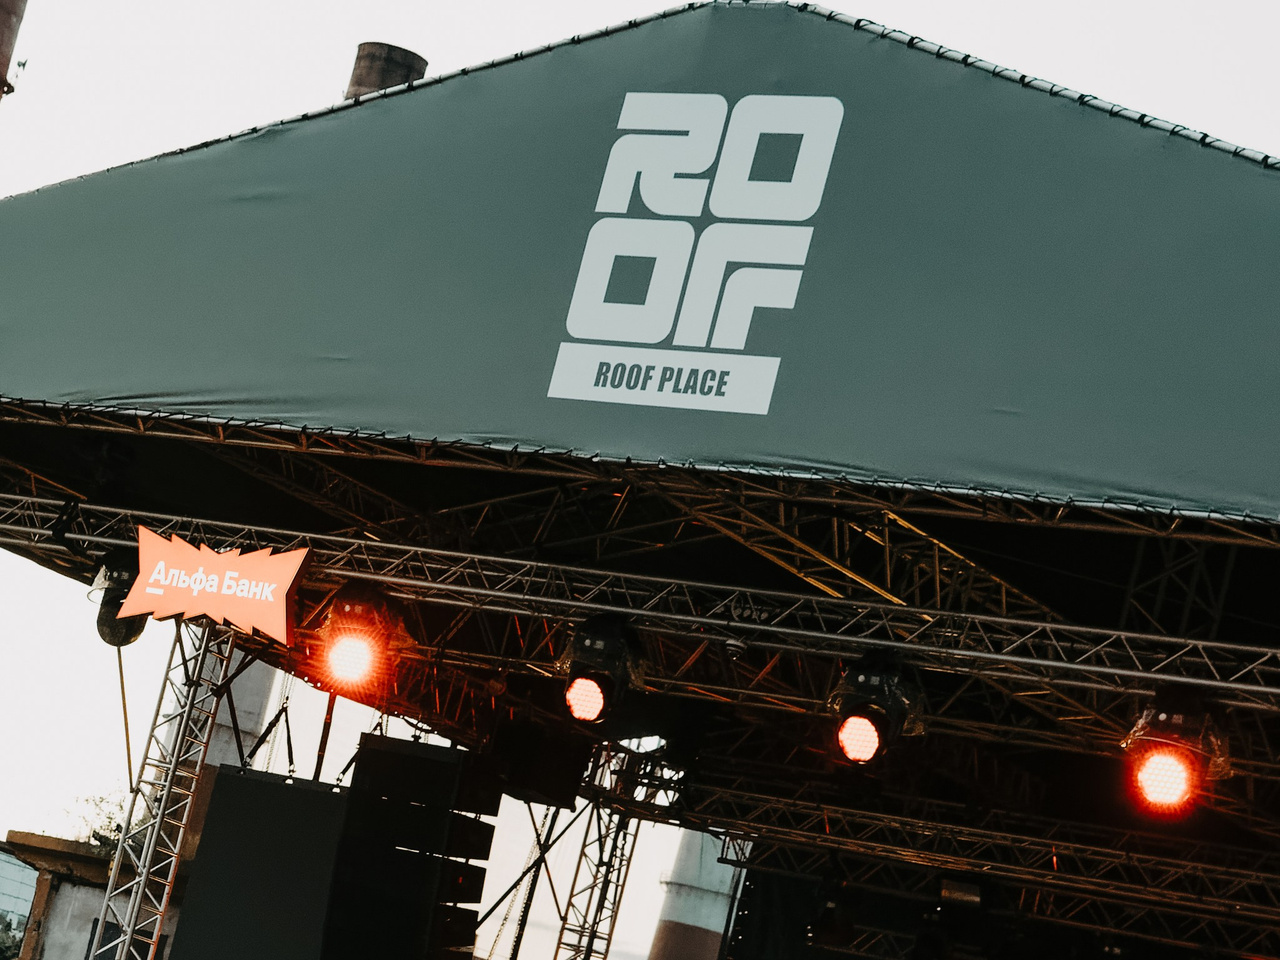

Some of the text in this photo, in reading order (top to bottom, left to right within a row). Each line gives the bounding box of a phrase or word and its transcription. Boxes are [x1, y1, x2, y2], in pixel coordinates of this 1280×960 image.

[594, 361, 731, 397] ROOF PLACE
[148, 560, 277, 602] Альфа Банк
